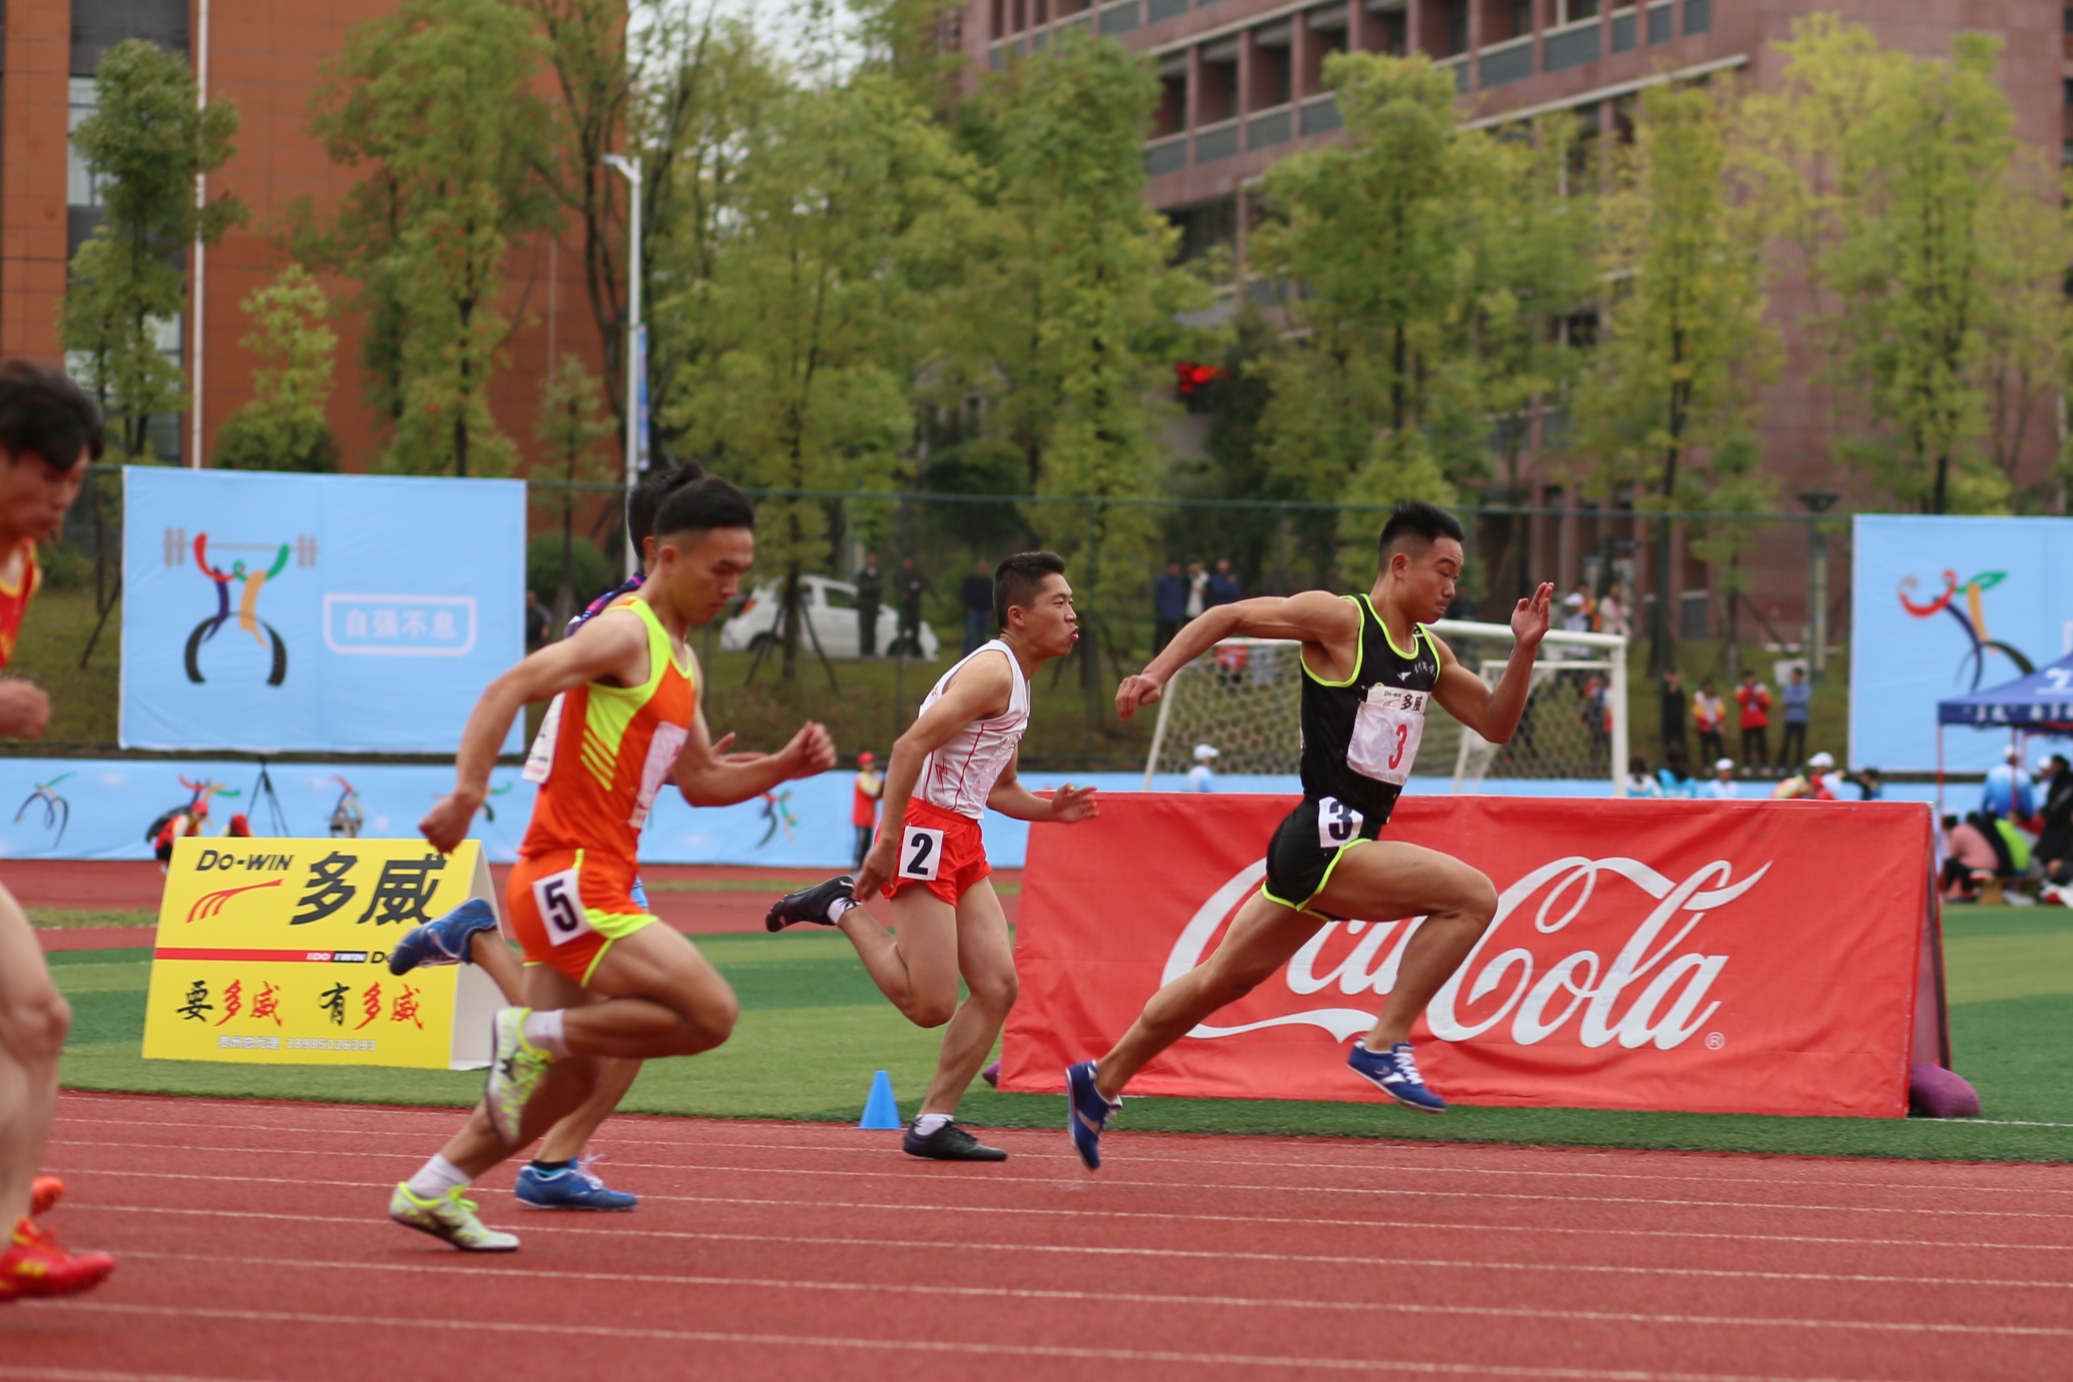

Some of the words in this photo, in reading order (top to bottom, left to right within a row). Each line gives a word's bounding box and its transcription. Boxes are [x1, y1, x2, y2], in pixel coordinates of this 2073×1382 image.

[346, 608, 456, 639] 自强不息
[1388, 723, 1407, 770] 3
[1328, 799, 1353, 841] 3
[907, 833, 933, 875] 2
[289, 851, 447, 926] 多威
[544, 879, 578, 932] 5
[177, 979, 283, 1027] 要多威
[320, 981, 423, 1030] 有多威
